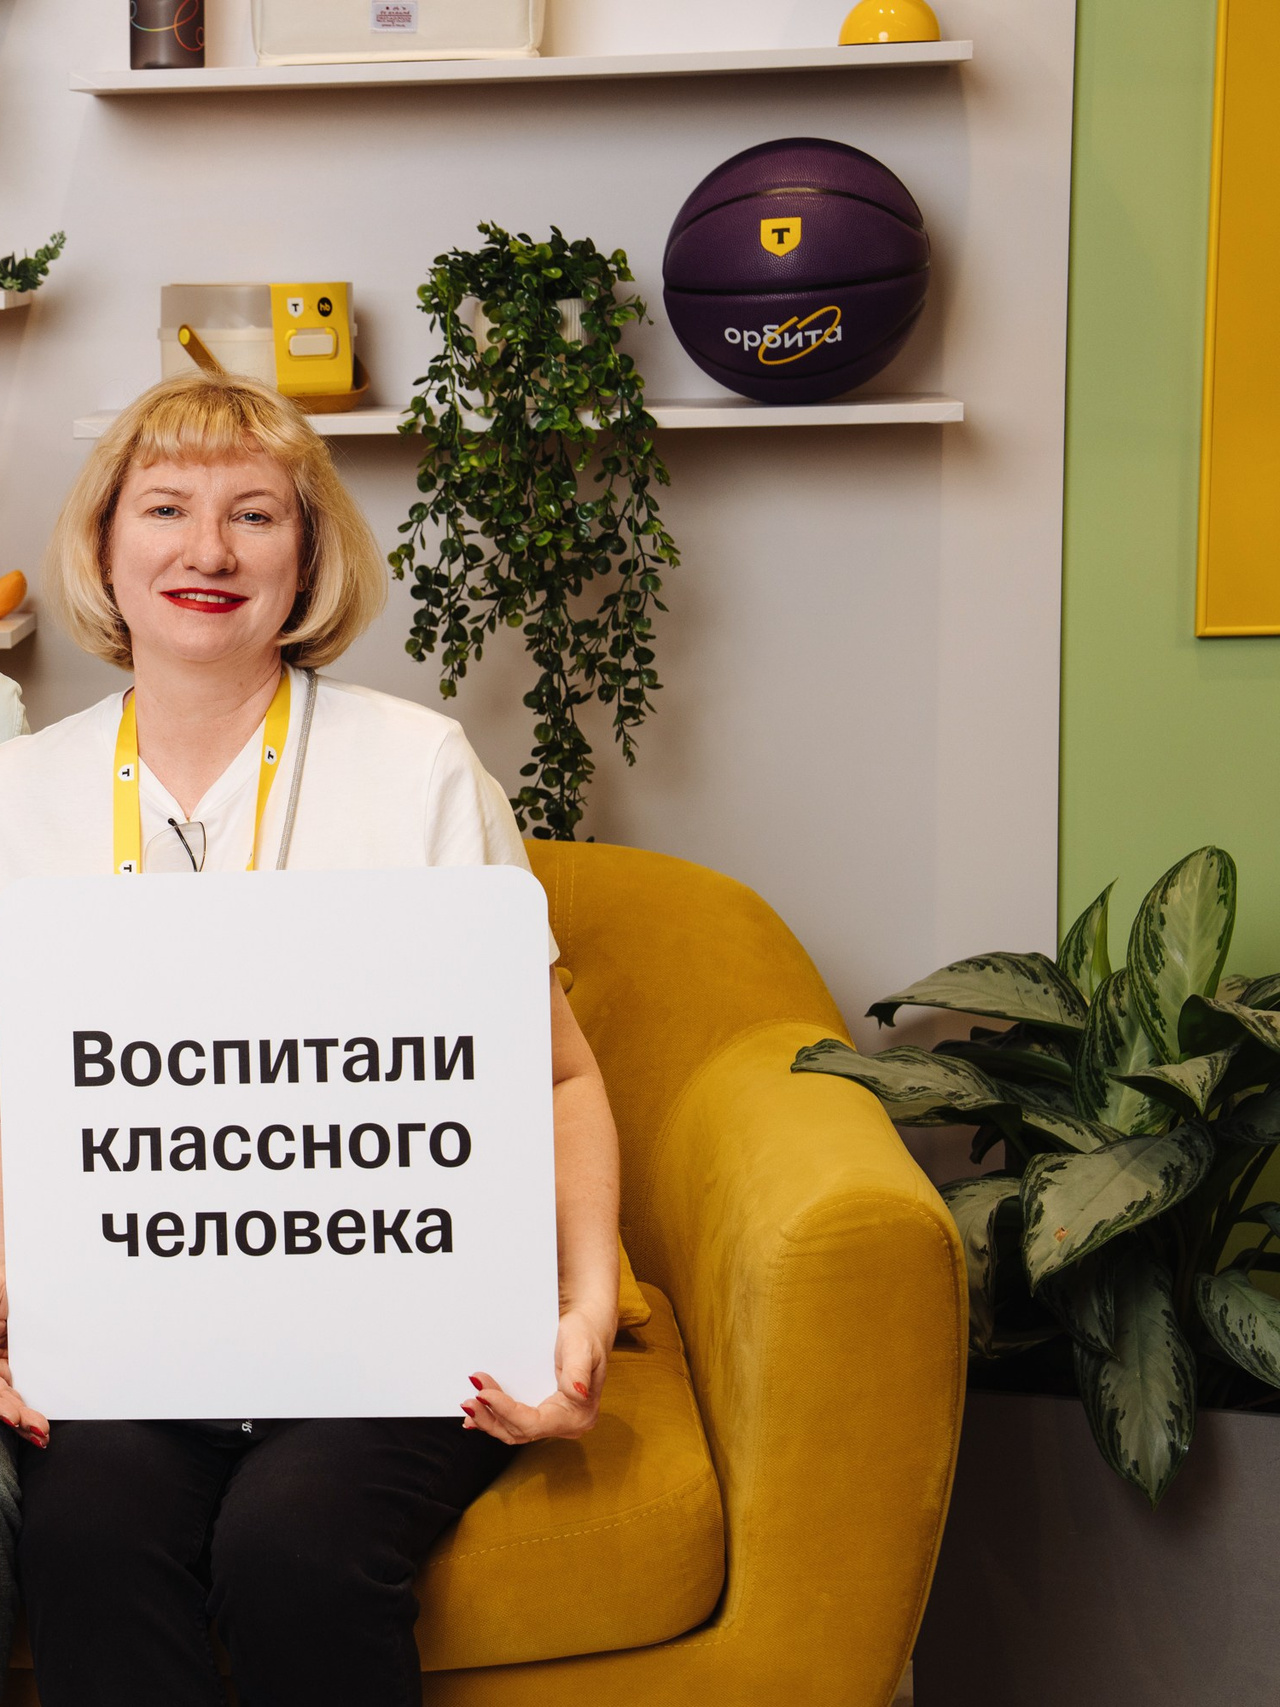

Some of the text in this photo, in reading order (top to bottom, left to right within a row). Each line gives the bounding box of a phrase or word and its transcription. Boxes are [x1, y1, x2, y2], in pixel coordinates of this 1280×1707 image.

[771, 227, 791, 245] Т
[72, 1030, 475, 1088] Воспитали
[81, 1121, 472, 1173] классного
[101, 1207, 453, 1258] человека
